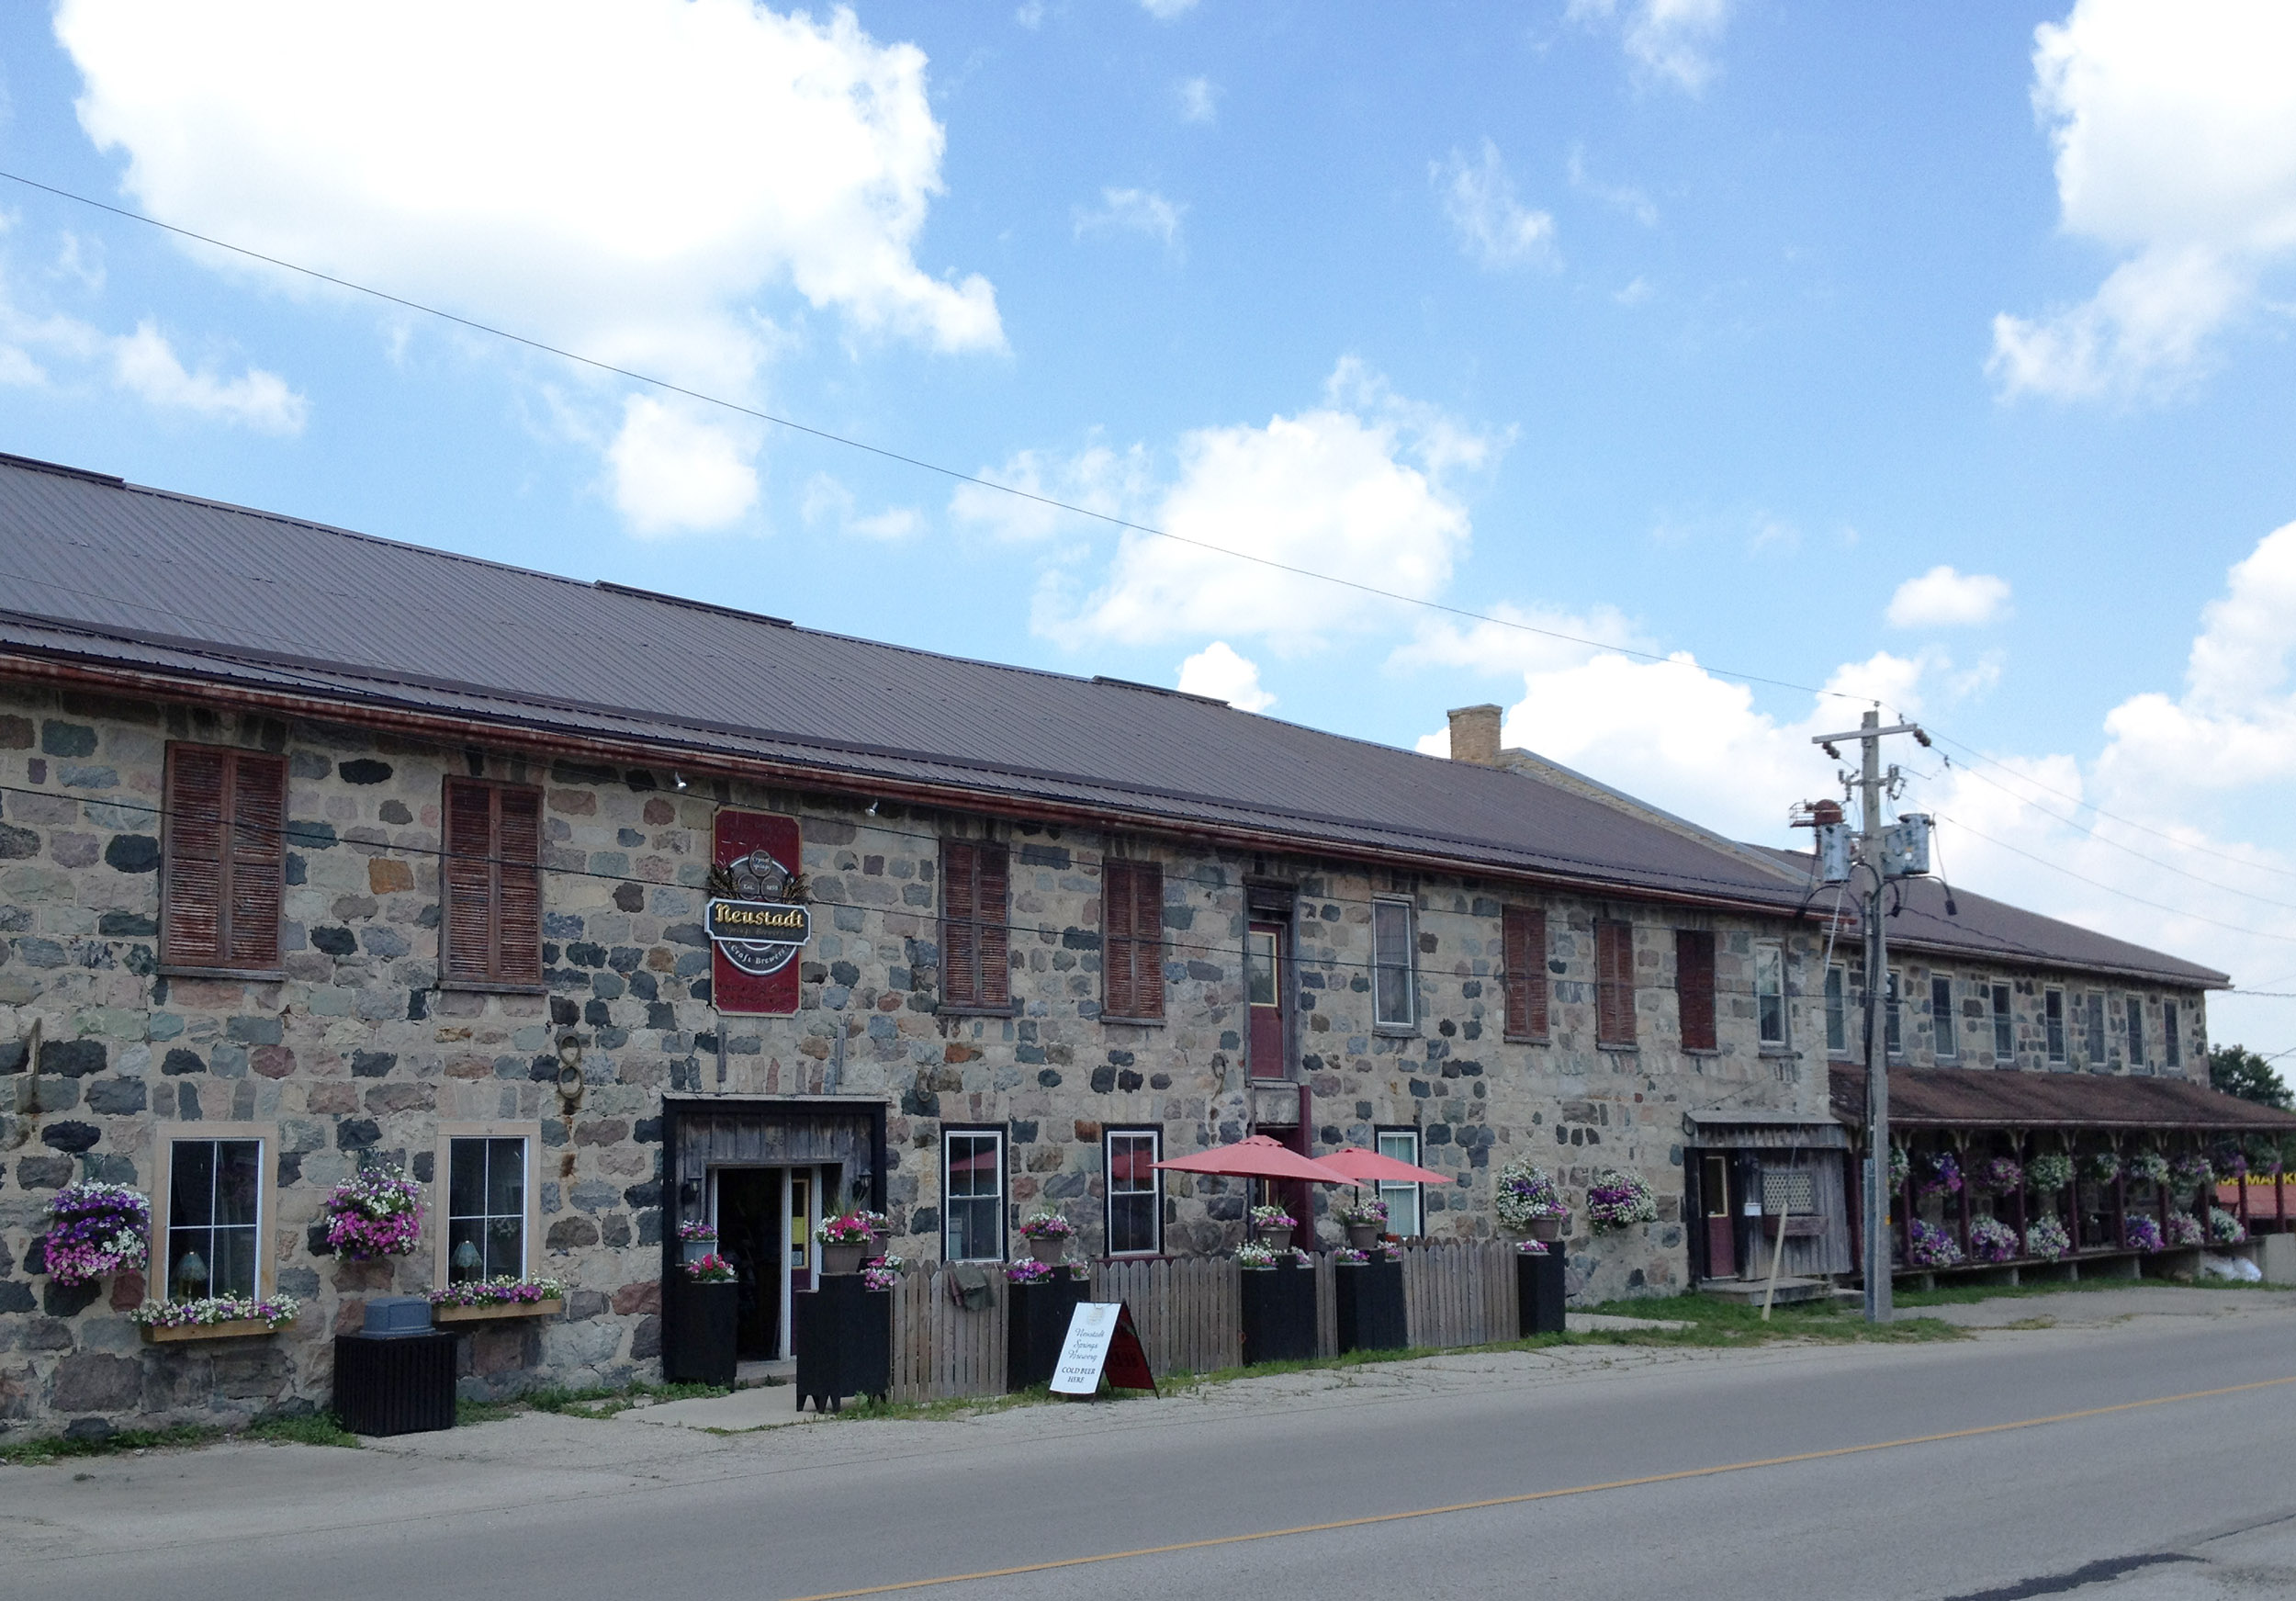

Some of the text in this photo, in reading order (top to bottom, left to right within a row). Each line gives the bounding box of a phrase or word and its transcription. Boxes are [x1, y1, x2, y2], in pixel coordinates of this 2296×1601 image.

[715, 903, 805, 929] Neustadt
[730, 944, 786, 964] Craft Brewers
[1075, 1327, 1105, 1338] Neustadt
[1073, 1339, 1098, 1353] Springs
[1067, 1350, 1098, 1363] Brewery
[1062, 1366, 1096, 1375] COLD BEER
[1067, 1375, 1086, 1383] HERE
